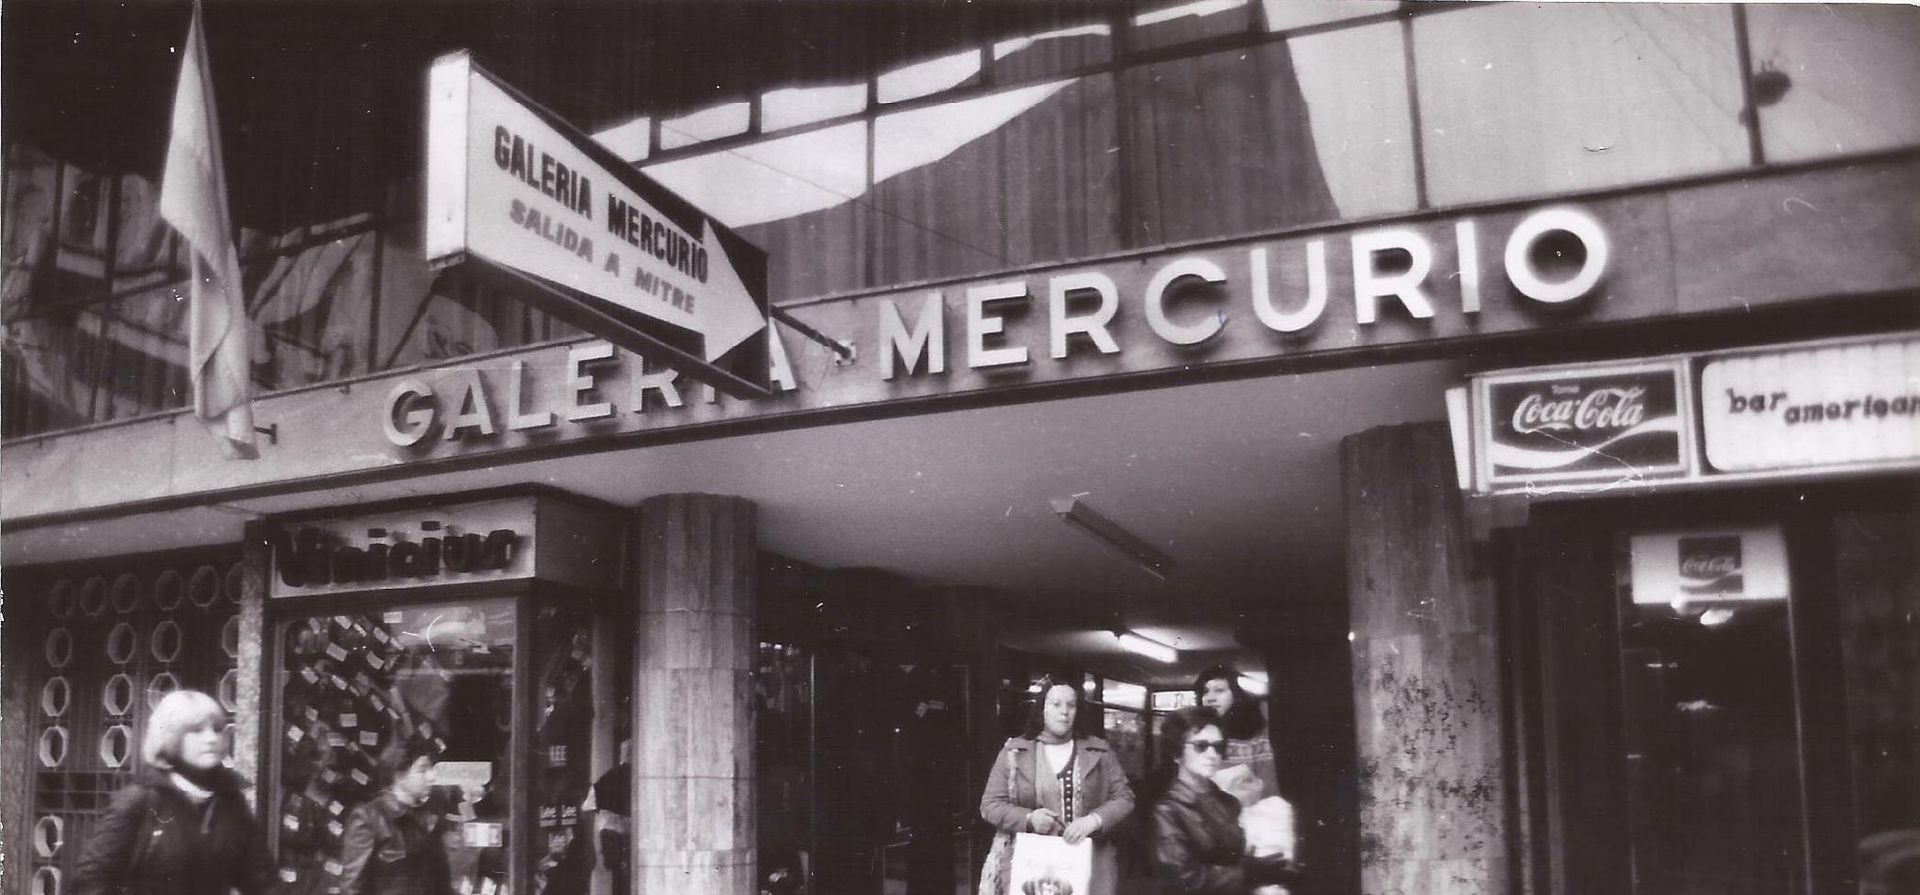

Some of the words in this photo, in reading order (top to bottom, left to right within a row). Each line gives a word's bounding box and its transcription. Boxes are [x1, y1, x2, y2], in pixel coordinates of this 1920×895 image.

[494, 124, 593, 221] GALERIA
[607, 192, 709, 284] MERCURIO
[510, 198, 593, 262] SALIDA
[604, 252, 620, 277] A
[634, 267, 695, 314] MITRE
[383, 317, 797, 447] GALERA
[879, 208, 1608, 379] MERCURIO
[1512, 386, 1646, 434] Coca-Cola
[1727, 388, 1787, 413] bar
